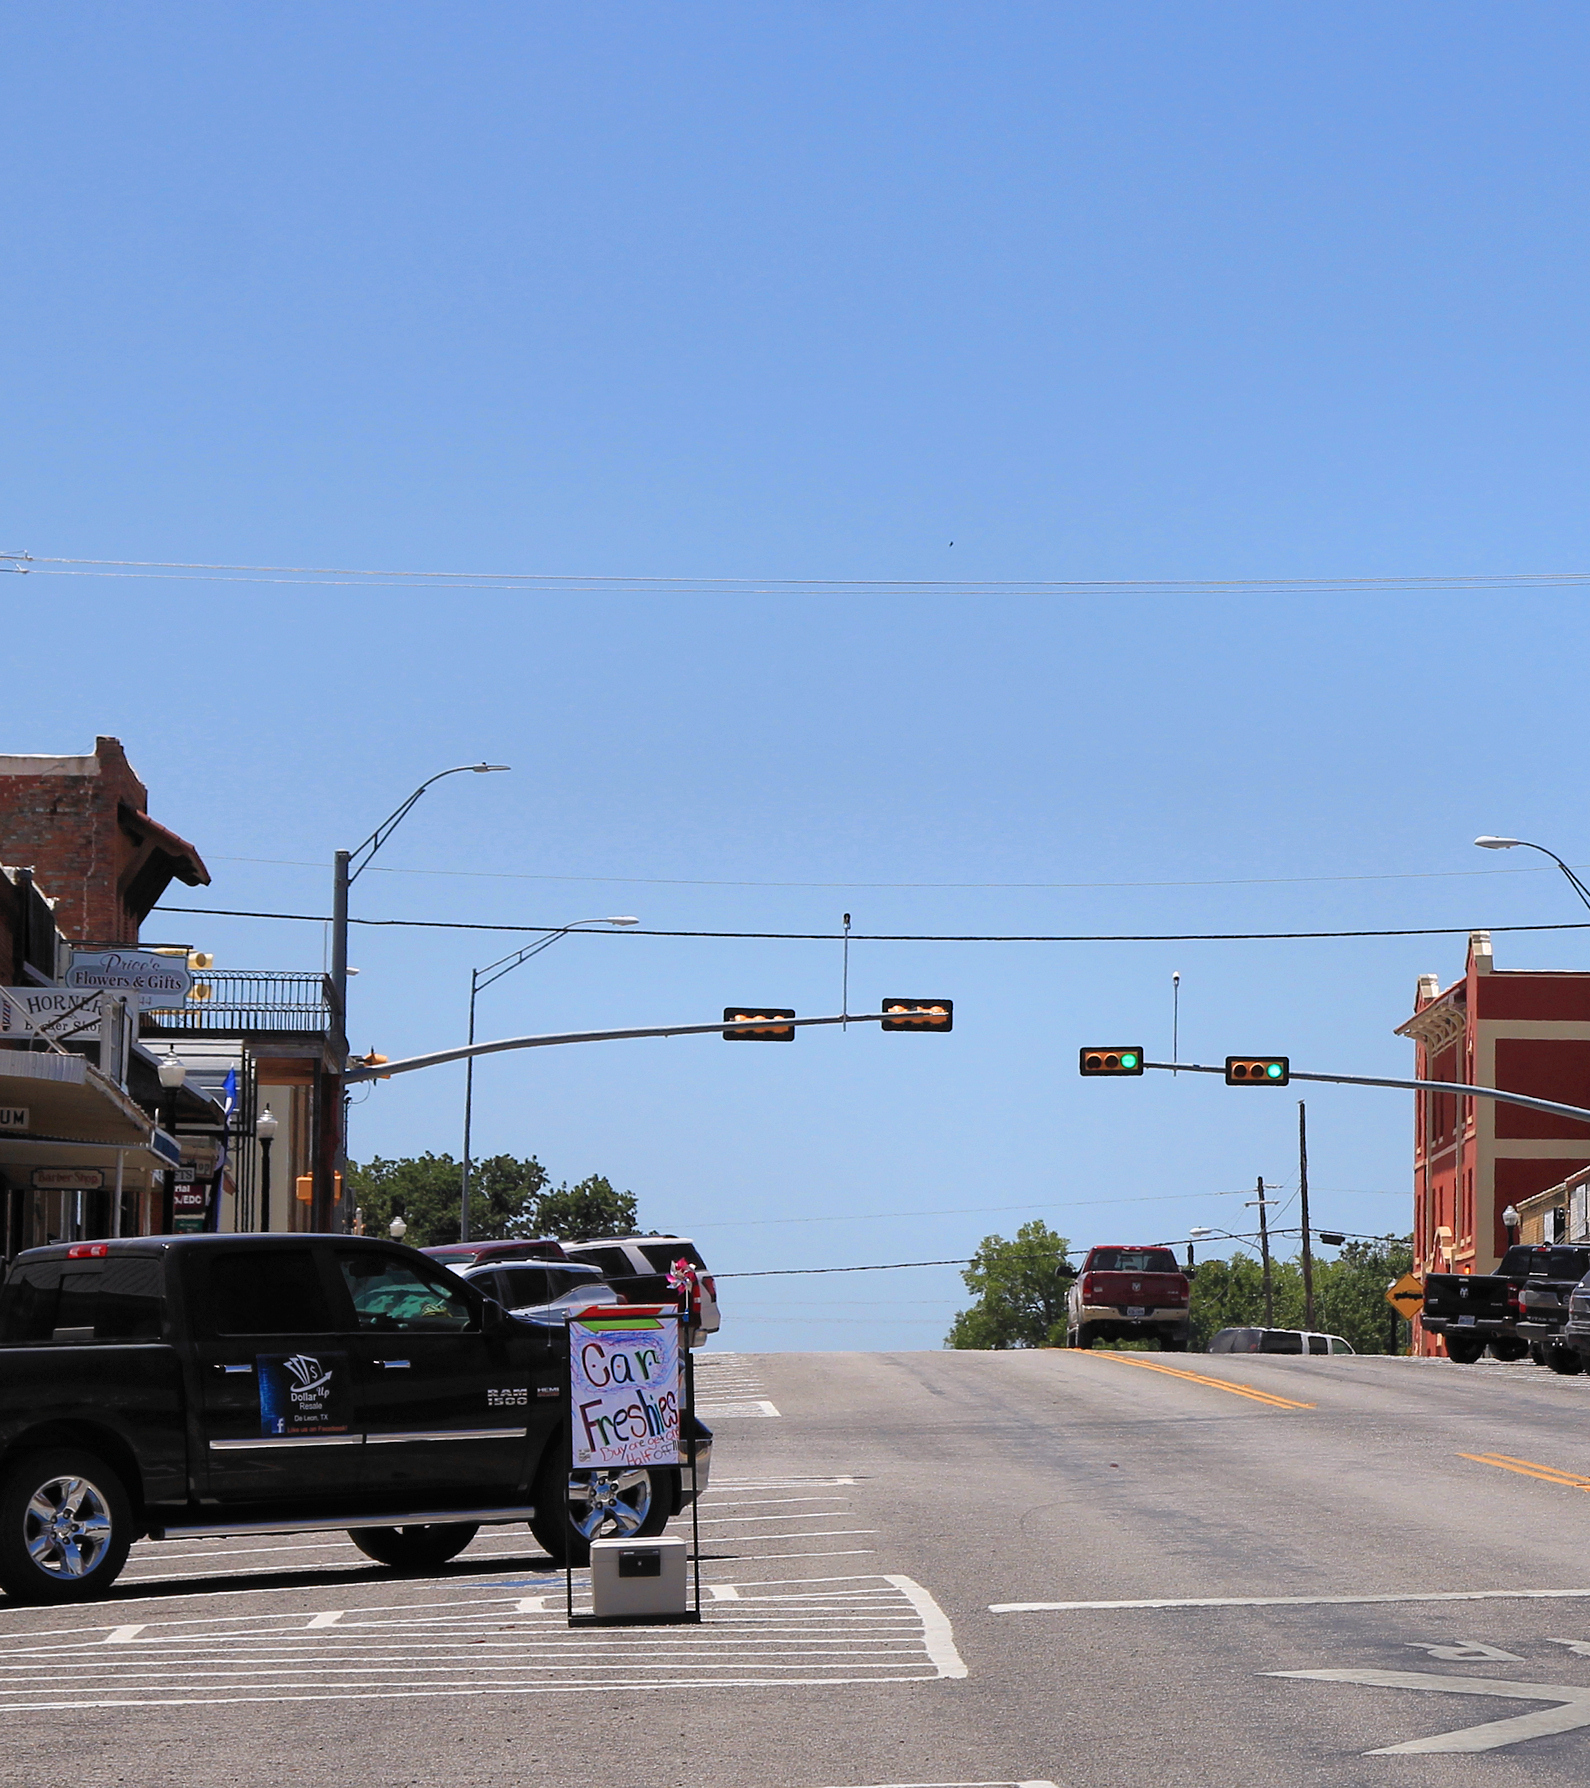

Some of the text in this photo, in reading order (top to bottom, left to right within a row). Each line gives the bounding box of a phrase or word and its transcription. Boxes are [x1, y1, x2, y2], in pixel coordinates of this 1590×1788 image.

[100, 953, 160, 973] Price's
[75, 972, 182, 990] Flowers & Gifts
[0, 1109, 25, 1125] UM
[581, 1342, 660, 1387] Car
[290, 1386, 330, 1402] Dollar Up
[487, 1388, 528, 1397] RAM
[299, 1402, 323, 1410] Resale
[488, 1397, 528, 1406] 1500
[579, 1388, 678, 1453] Freshies
[600, 1443, 627, 1462] Buy
[628, 1439, 645, 1451] one
[647, 1434, 665, 1451] get
[626, 1449, 652, 1466] Half
